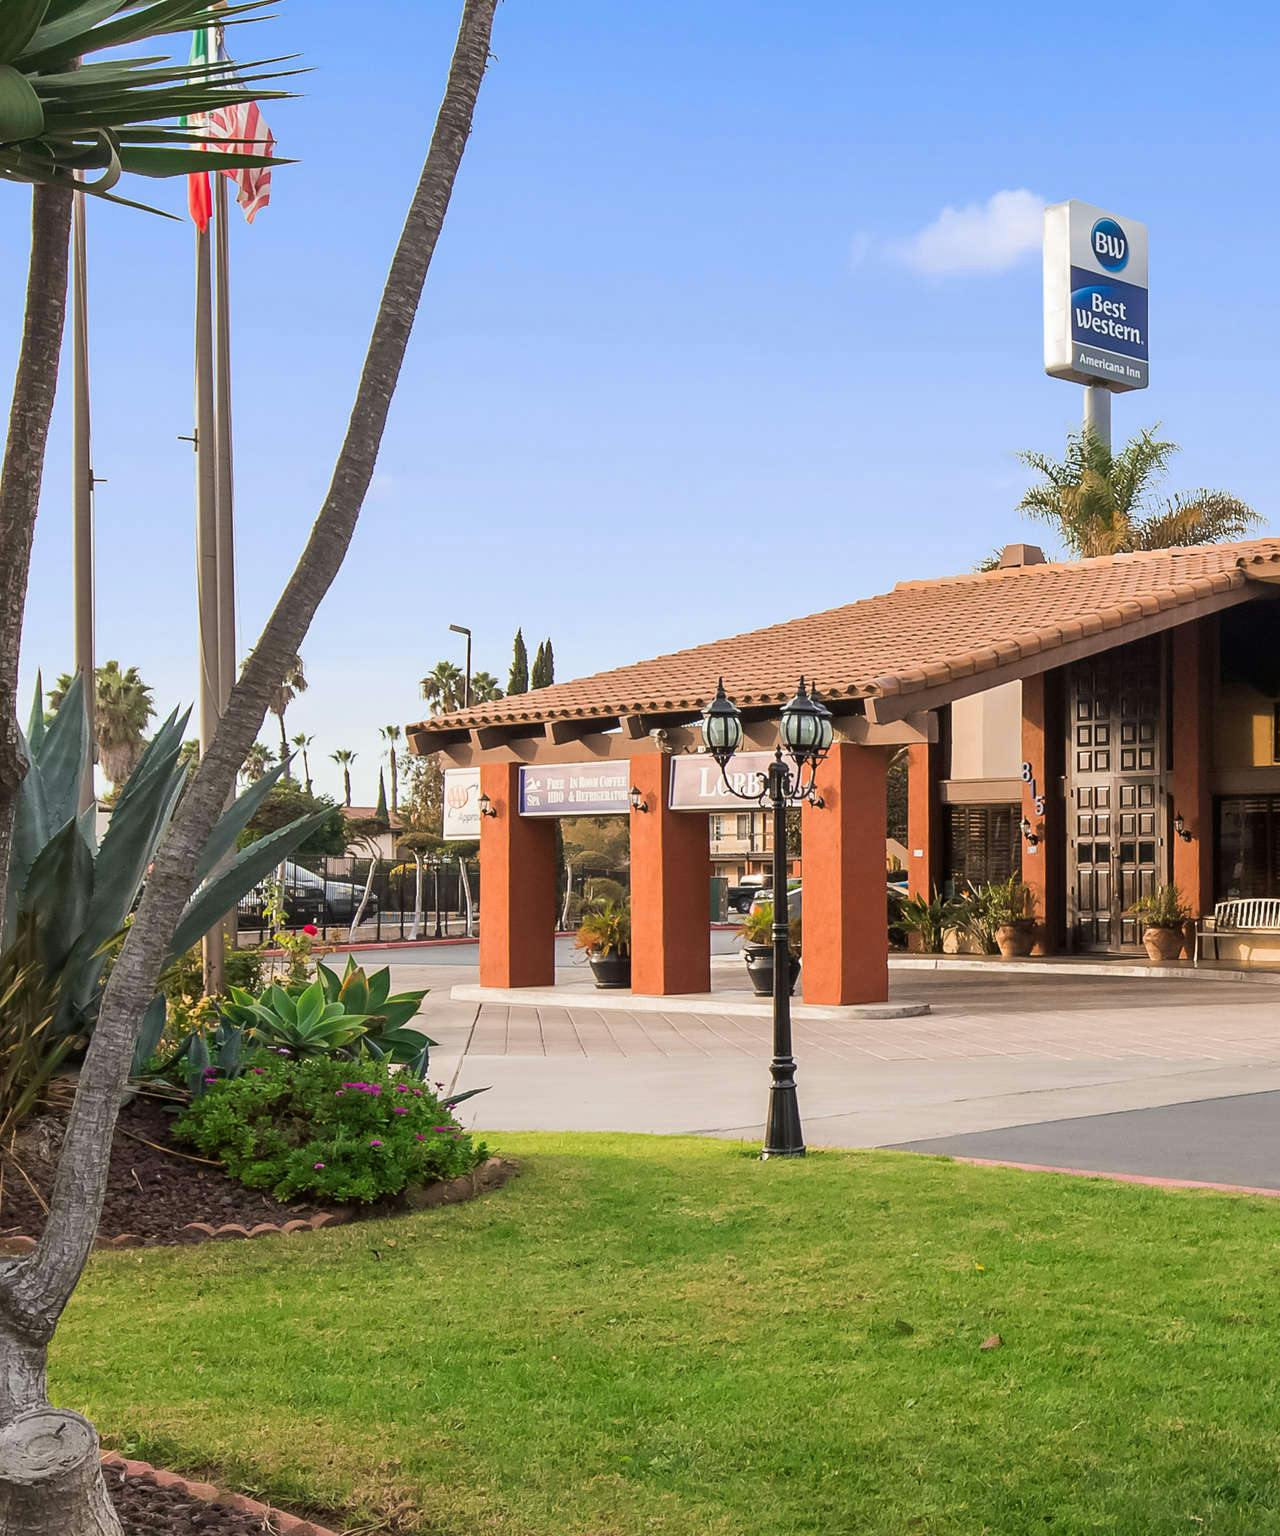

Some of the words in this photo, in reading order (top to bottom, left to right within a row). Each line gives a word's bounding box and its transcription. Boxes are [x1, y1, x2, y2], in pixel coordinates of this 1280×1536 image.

[1095, 231, 1125, 259] BW
[1091, 293, 1126, 320] Best
[1079, 352, 1125, 375] Americana
[1126, 365, 1141, 379] Inn
[699, 767, 770, 798] LOBB
[527, 793, 541, 806] SPA
